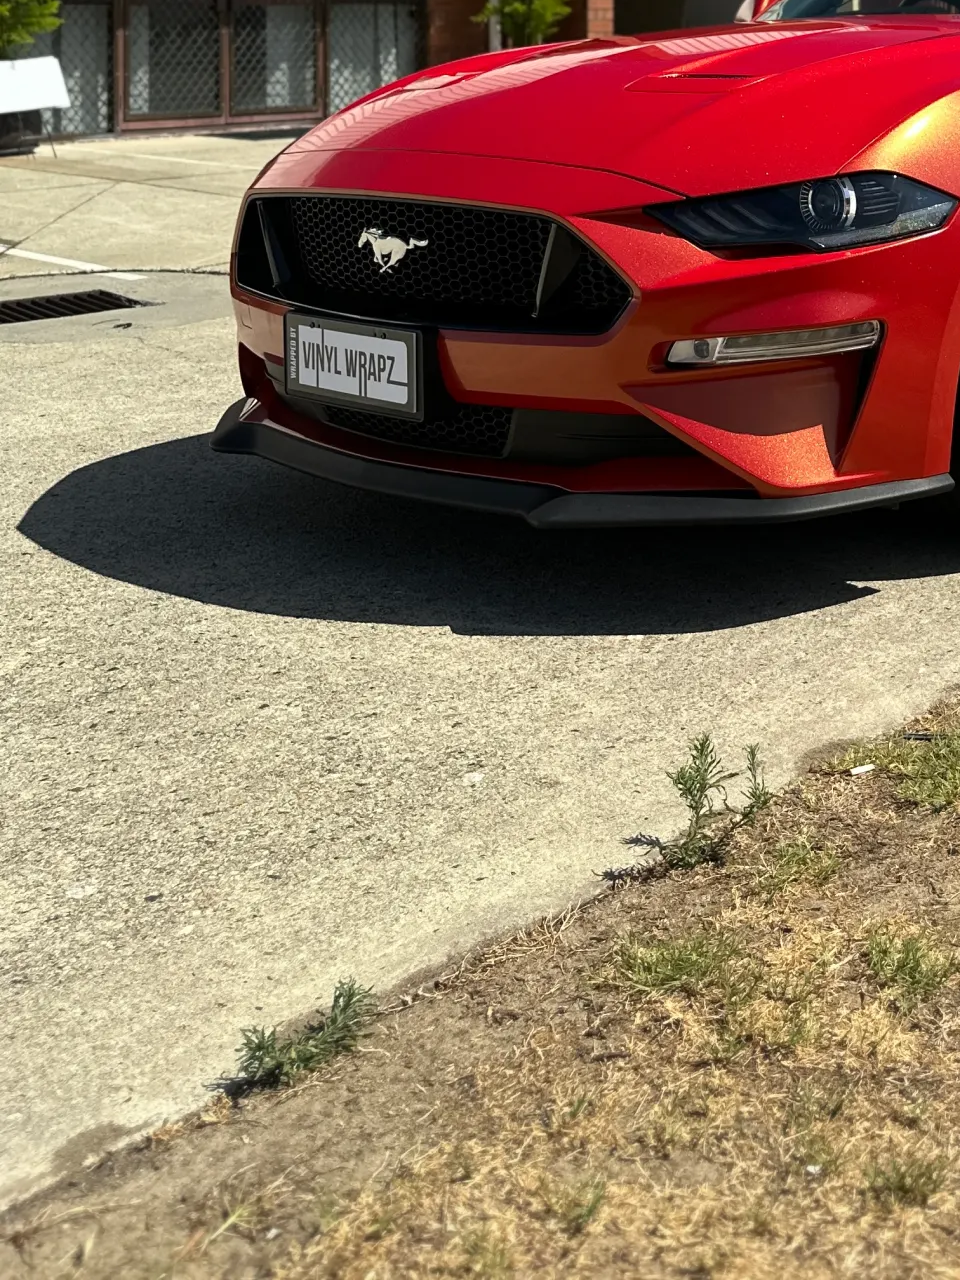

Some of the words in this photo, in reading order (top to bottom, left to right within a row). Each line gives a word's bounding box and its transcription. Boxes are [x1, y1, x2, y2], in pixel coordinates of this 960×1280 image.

[290, 327, 297, 338] BY
[302, 329, 342, 388] VINYL
[344, 348, 408, 398] WRAPZ
